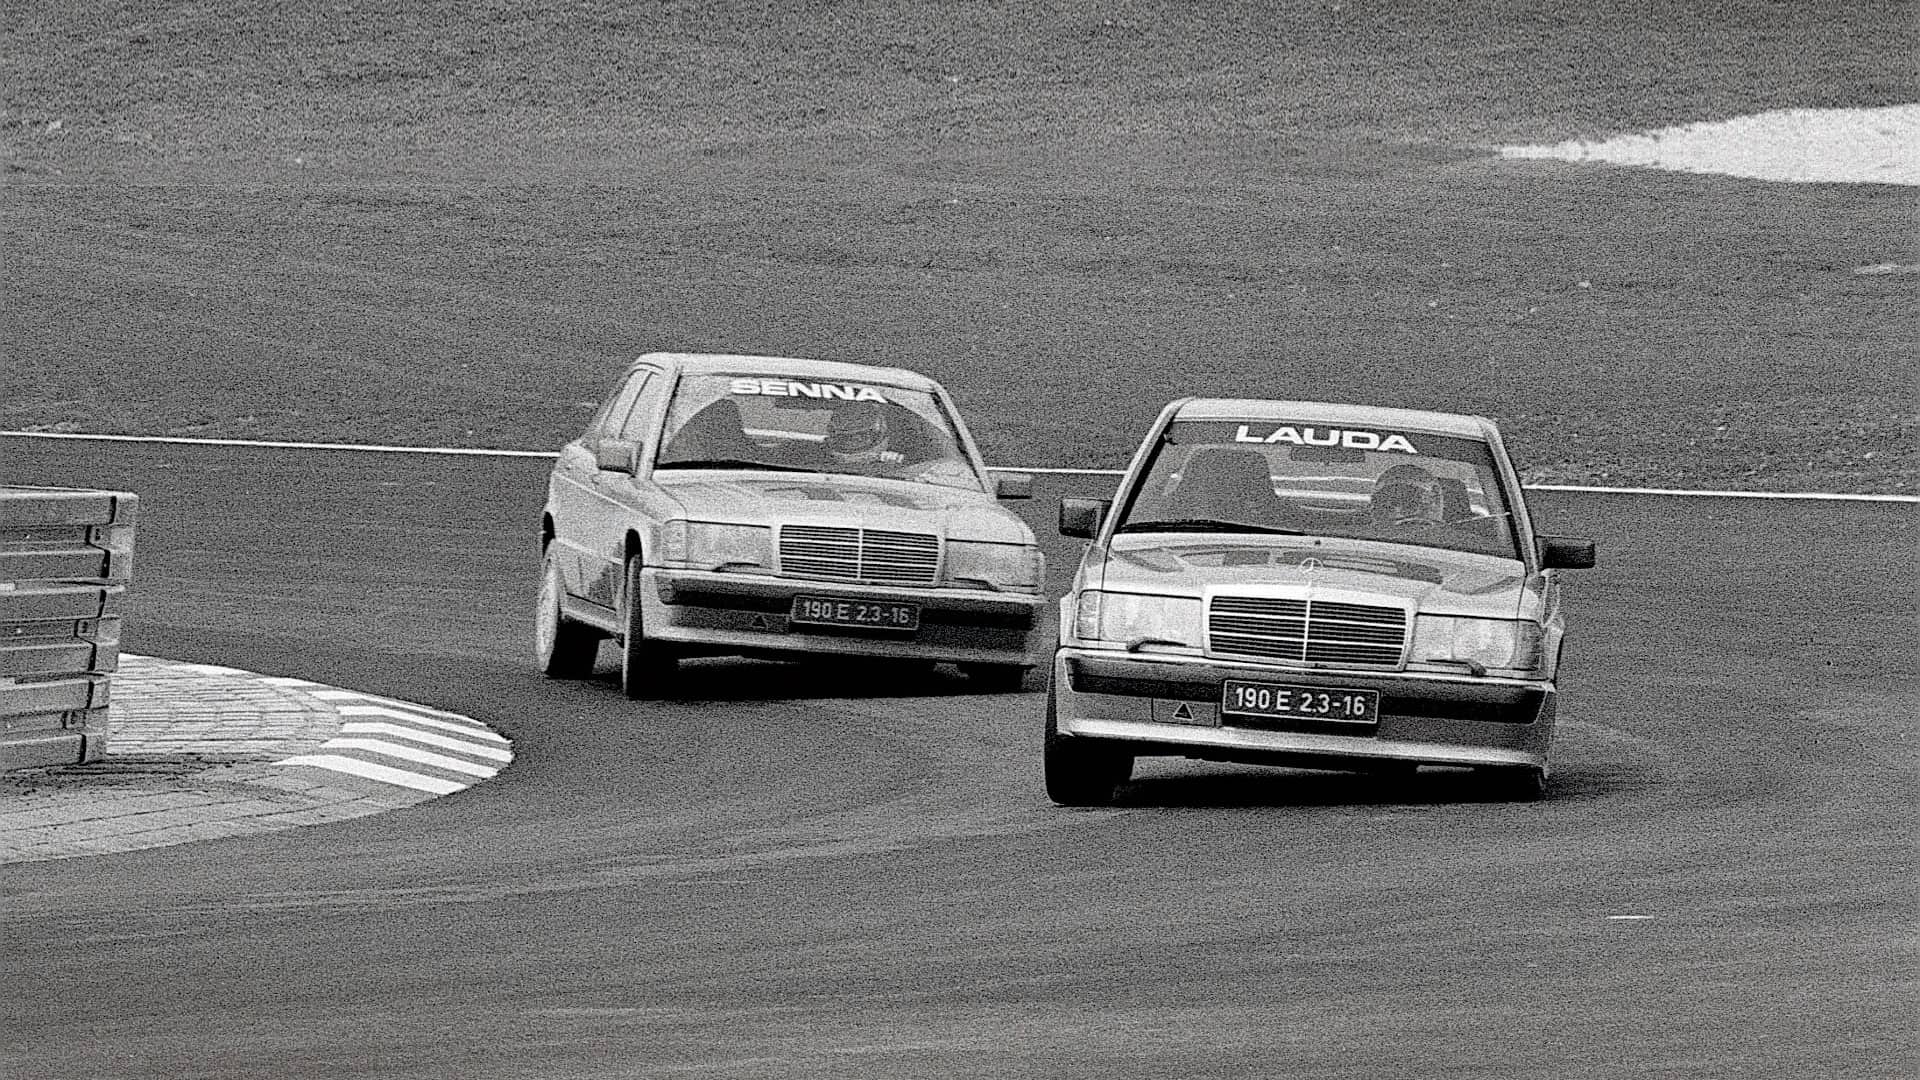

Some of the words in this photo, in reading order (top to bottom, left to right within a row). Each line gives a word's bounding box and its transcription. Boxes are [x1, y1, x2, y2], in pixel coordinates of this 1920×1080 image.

[729, 378, 890, 404] SENNA
[1235, 425, 1418, 453] LAUDA
[803, 600, 832, 619] 190
[837, 603, 851, 620] E
[1236, 687, 1270, 709] 190
[1277, 691, 1291, 711] E
[1300, 692, 1367, 716] 2.3-16
